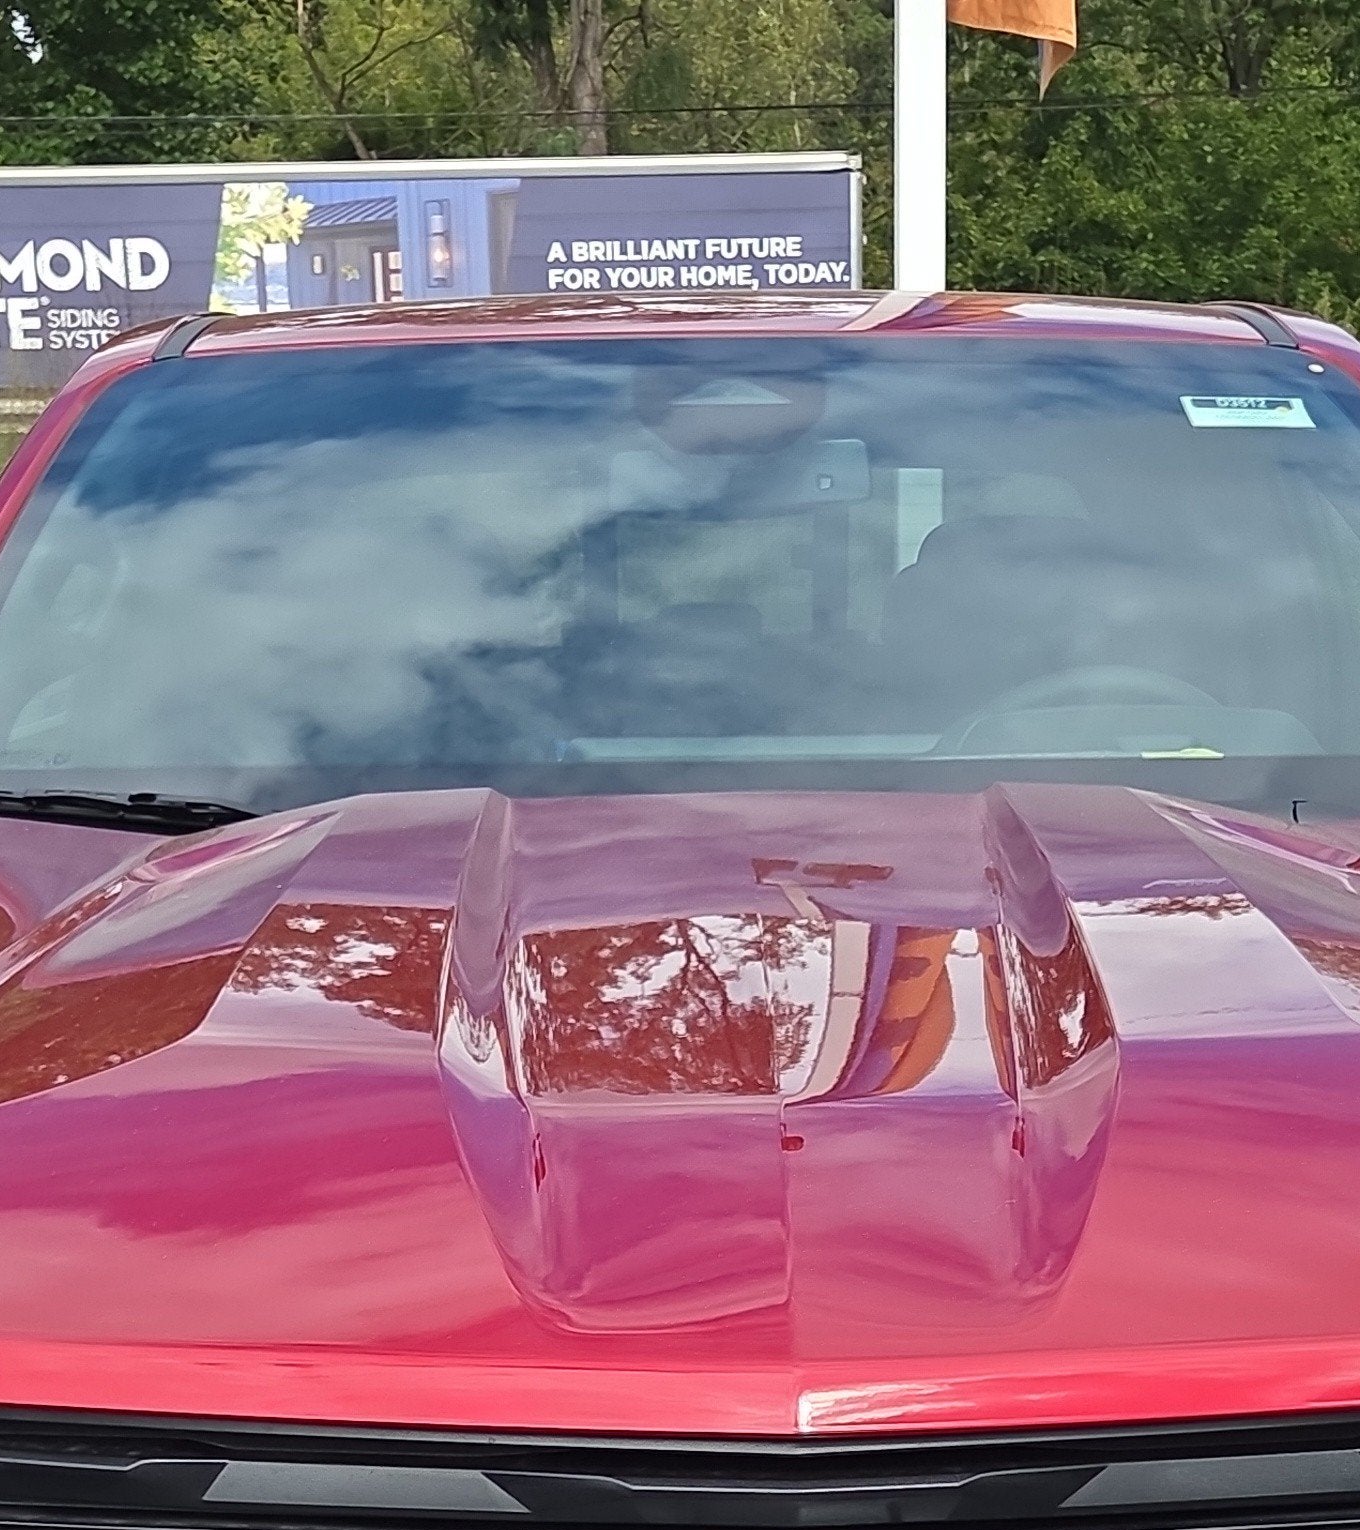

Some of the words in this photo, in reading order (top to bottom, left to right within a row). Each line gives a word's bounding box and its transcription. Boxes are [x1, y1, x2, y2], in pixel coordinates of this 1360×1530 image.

[547, 240, 568, 263] A
[571, 238, 700, 263] BRILLIANT
[705, 236, 803, 259] FUTURE
[548, 267, 601, 290] FOR
[604, 265, 675, 289] YOUR
[680, 264, 760, 291] HOME,
[763, 261, 850, 285] TODAY.
[46, 308, 121, 329] SIDING
